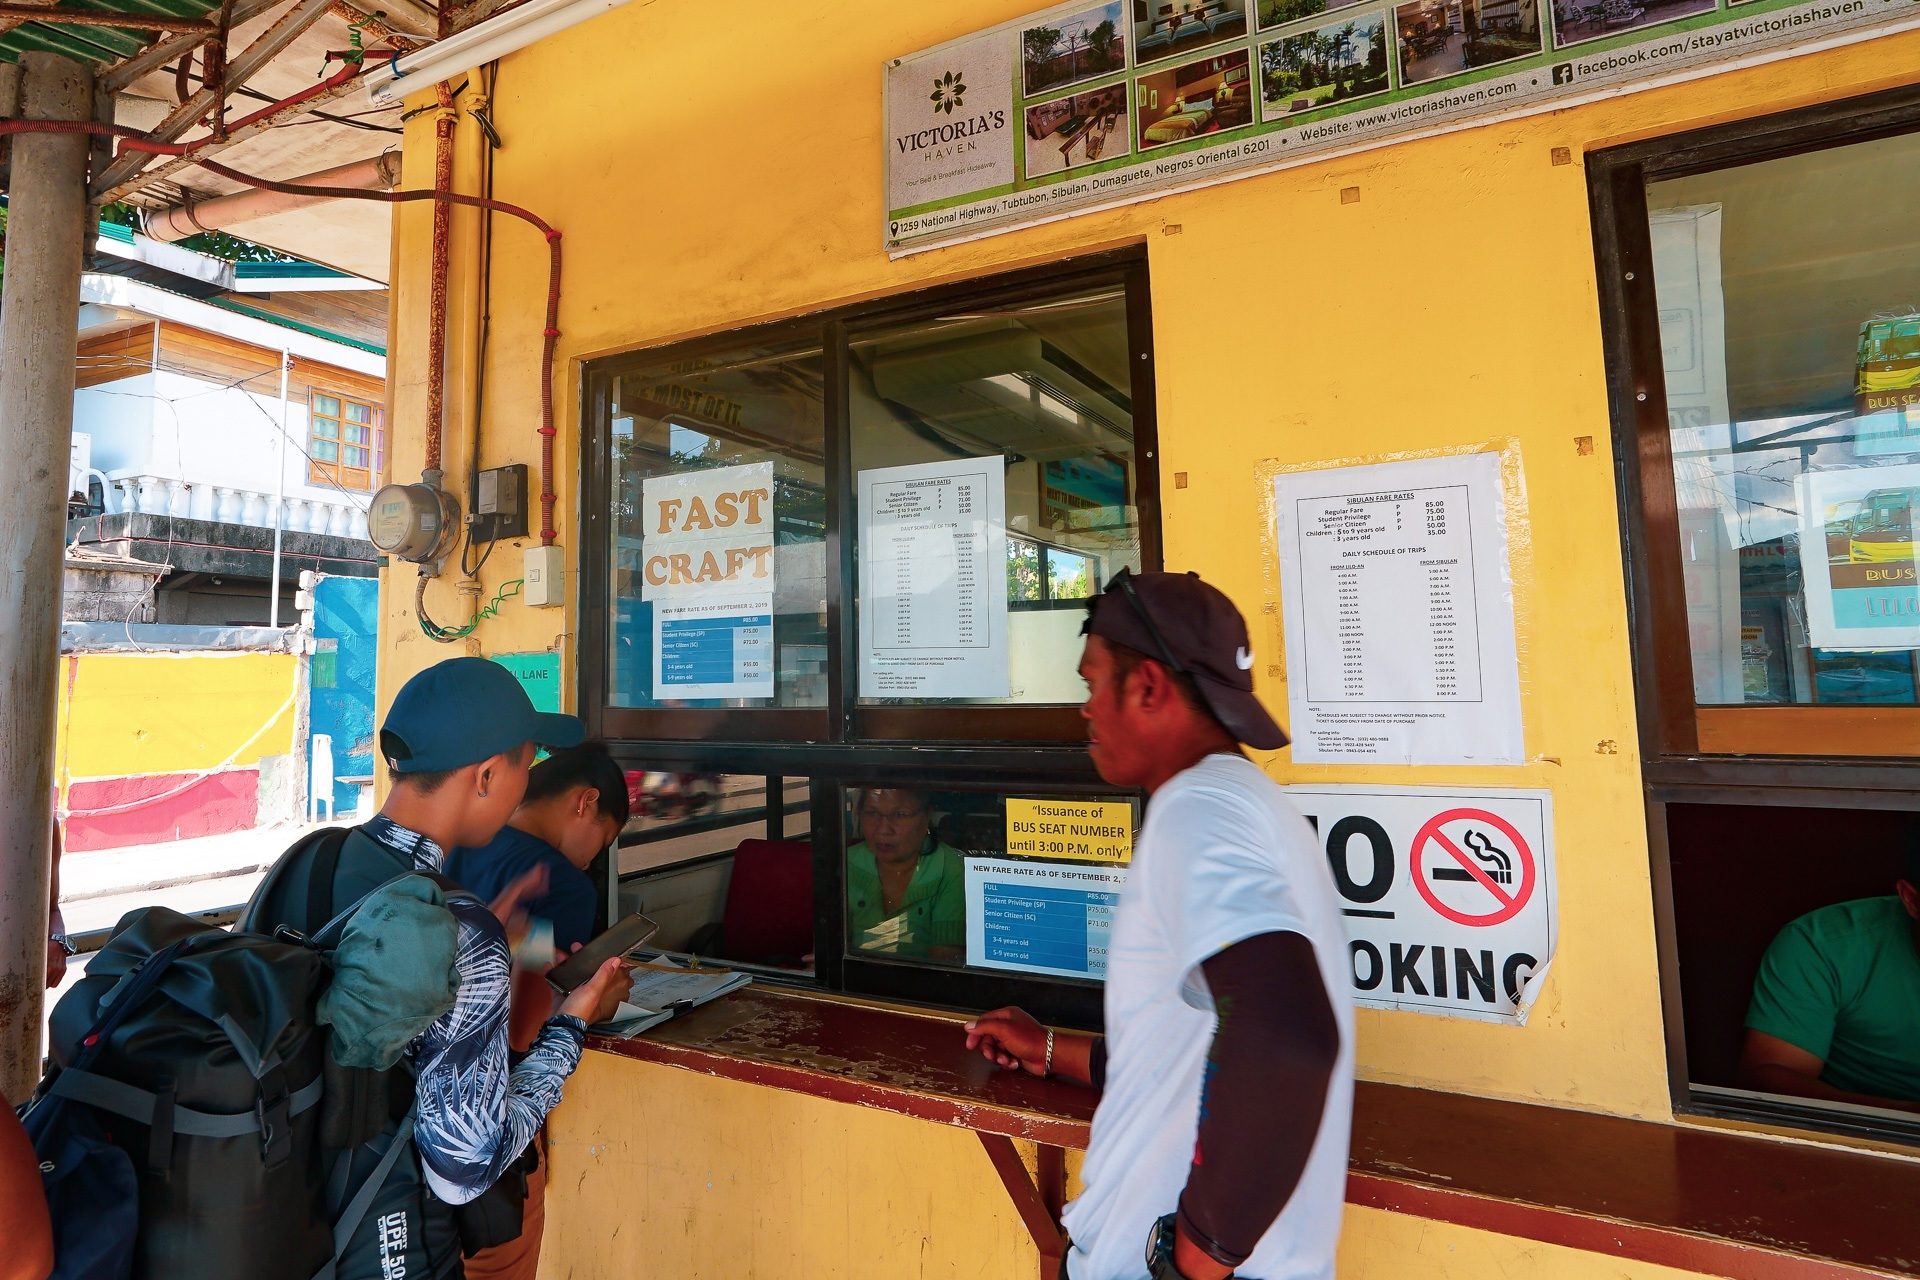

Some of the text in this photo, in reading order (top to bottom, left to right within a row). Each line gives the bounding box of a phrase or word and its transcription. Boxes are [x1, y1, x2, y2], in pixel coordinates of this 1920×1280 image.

[1577, 1, 1863, 76] facebook.com/stayatvictoriashaven
[1300, 80, 1517, 142] Website: www.victoriashaven.com
[924, 141, 976, 162] HAVEN
[905, 178, 918, 188] Your
[920, 174, 932, 184] Bed
[938, 167, 966, 180] Breakfast
[967, 160, 996, 173] Hideaway
[900, 140, 1270, 234] 1259 National Highway, Tubtubon, Sibulan, Dumaguete, Negros Oriental 6201
[1869, 396, 1897, 408] BUS
[657, 488, 768, 534] FAST
[645, 545, 772, 587] CRAFT
[1866, 568, 1916, 581] BUS
[522, 670, 548, 679] LANE
[1091, 807, 1103, 818] of
[1013, 822, 1125, 838] BUS SEAT NUMBER
[1010, 840, 1035, 851] until
[1039, 841, 1064, 853] 3:00
[1068, 843, 1092, 855] P.M.
[1302, 815, 1395, 904] O
[1061, 872, 1110, 882] SEPTEMBER
[1114, 875, 1121, 884] 2,
[985, 897, 1006, 905] Student
[1008, 899, 1032, 908] Privilege
[1034, 901, 1045, 909] (SP)
[1004, 912, 1023, 920] Citizen
[1024, 913, 1036, 922] (SC)
[985, 922, 1011, 932] Children:
[1348, 939, 1538, 1005] OKING
[387, 1212, 406, 1280] UPF 50
